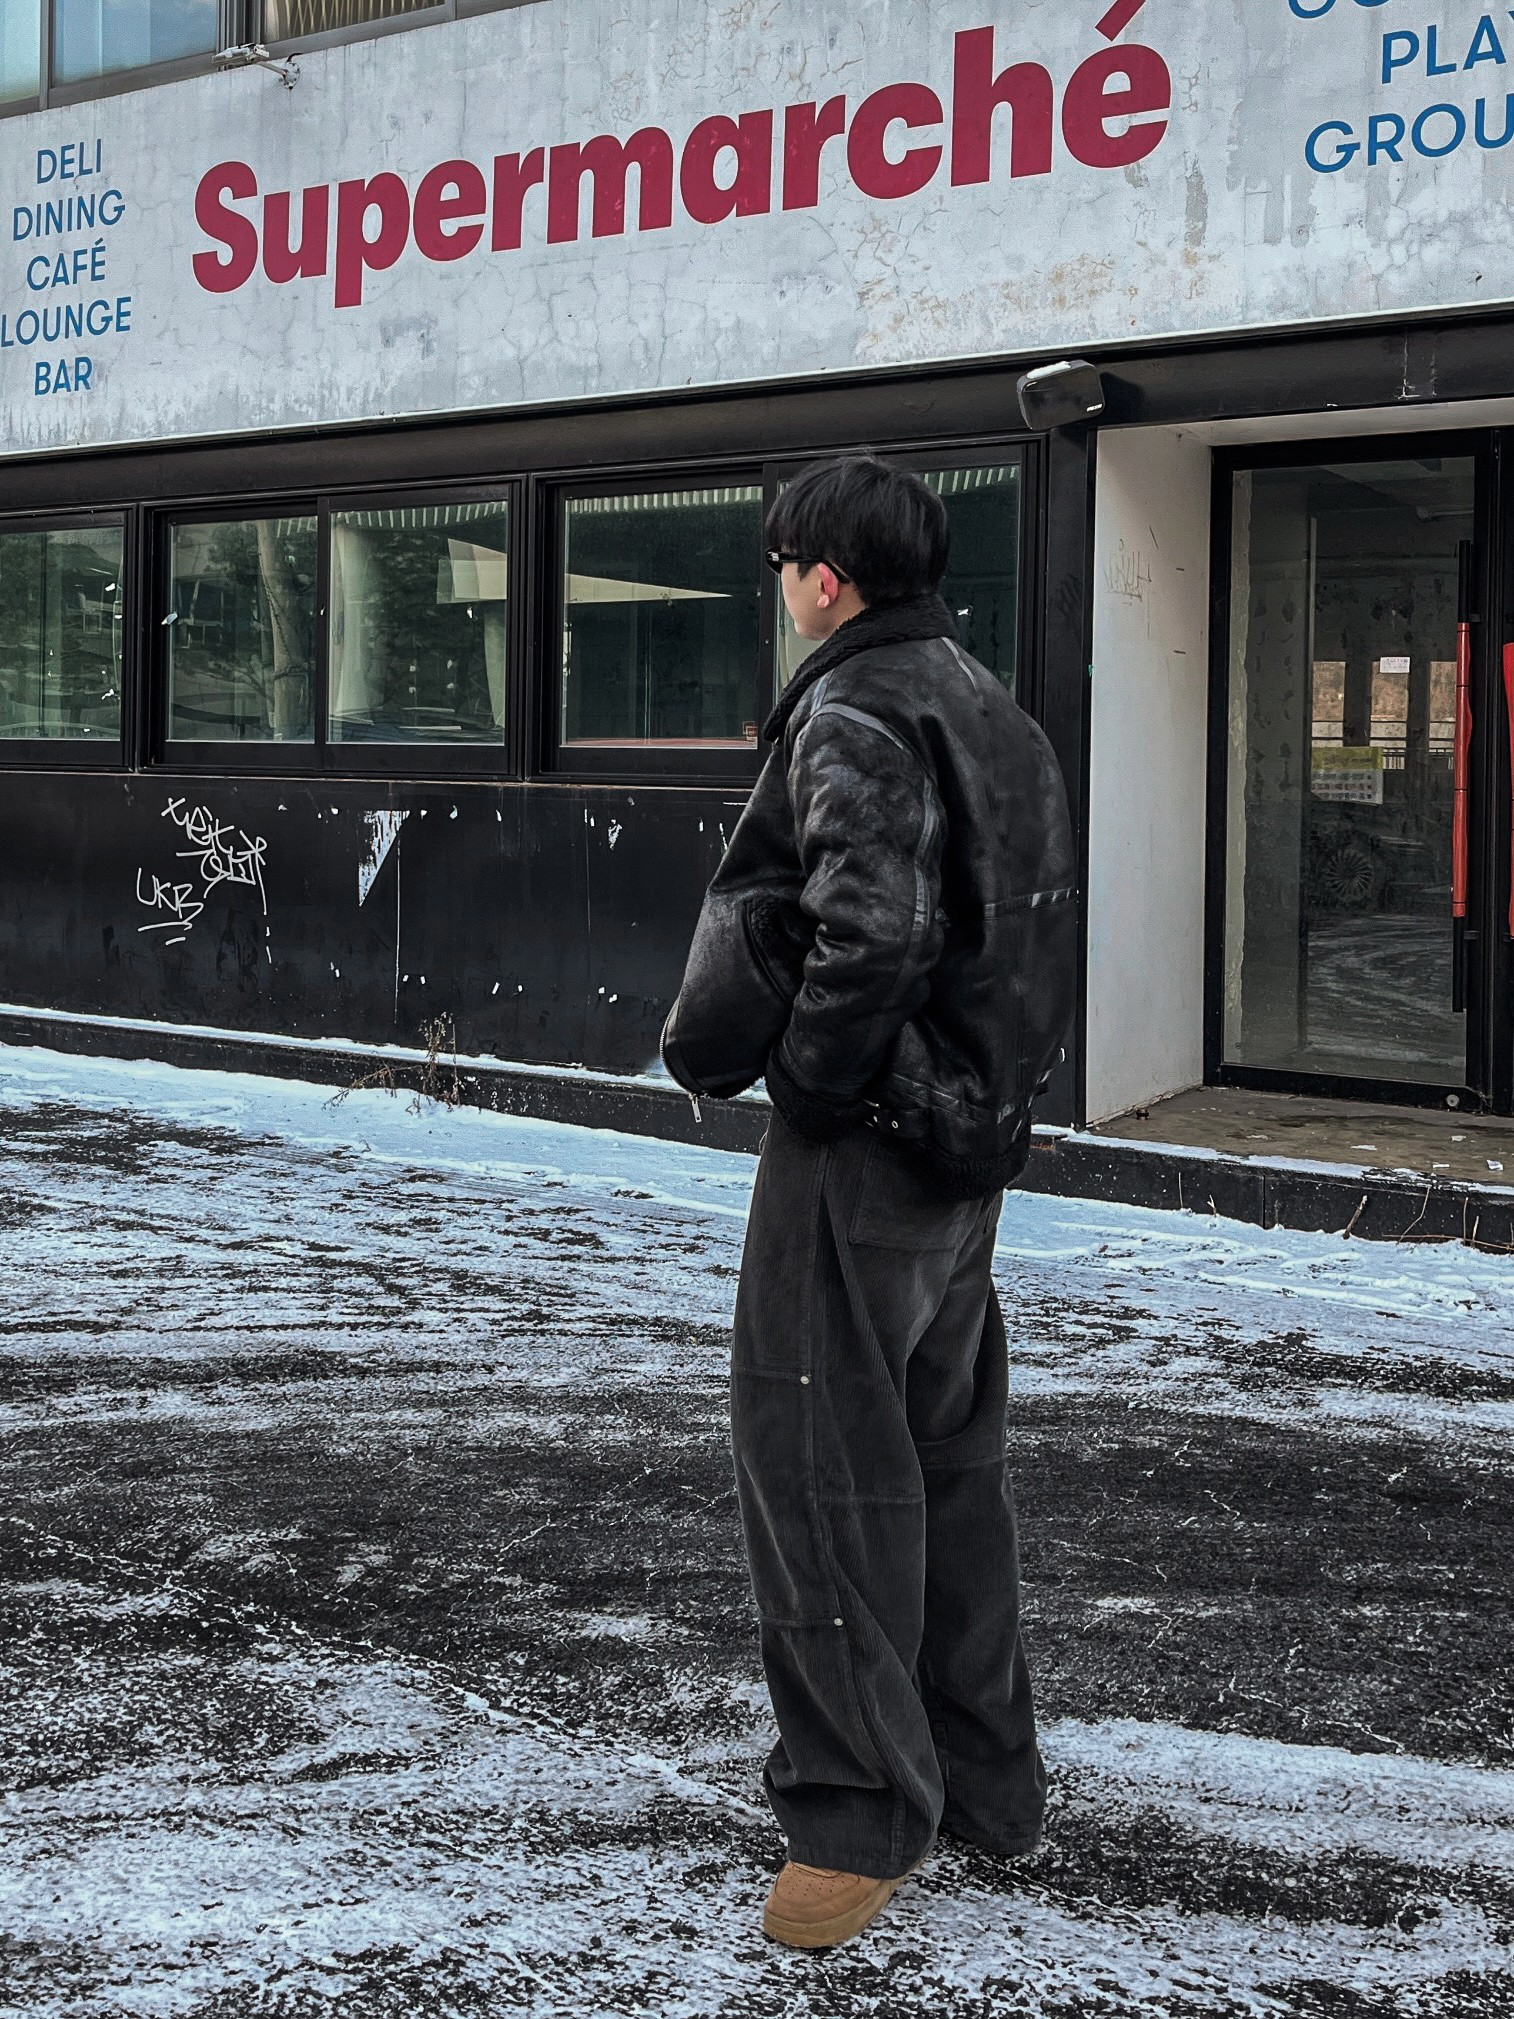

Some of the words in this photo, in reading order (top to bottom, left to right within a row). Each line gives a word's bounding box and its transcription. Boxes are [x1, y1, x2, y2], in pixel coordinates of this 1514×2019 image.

[1381, 11, 1514, 84] PLA
[37, 138, 102, 184] DELI
[193, 0, 1171, 307] Supermarché
[13, 189, 126, 241] DINING
[26, 237, 106, 291] CAFÉ
[0, 296, 132, 348] LOUNGE
[34, 356, 93, 396] BAR
